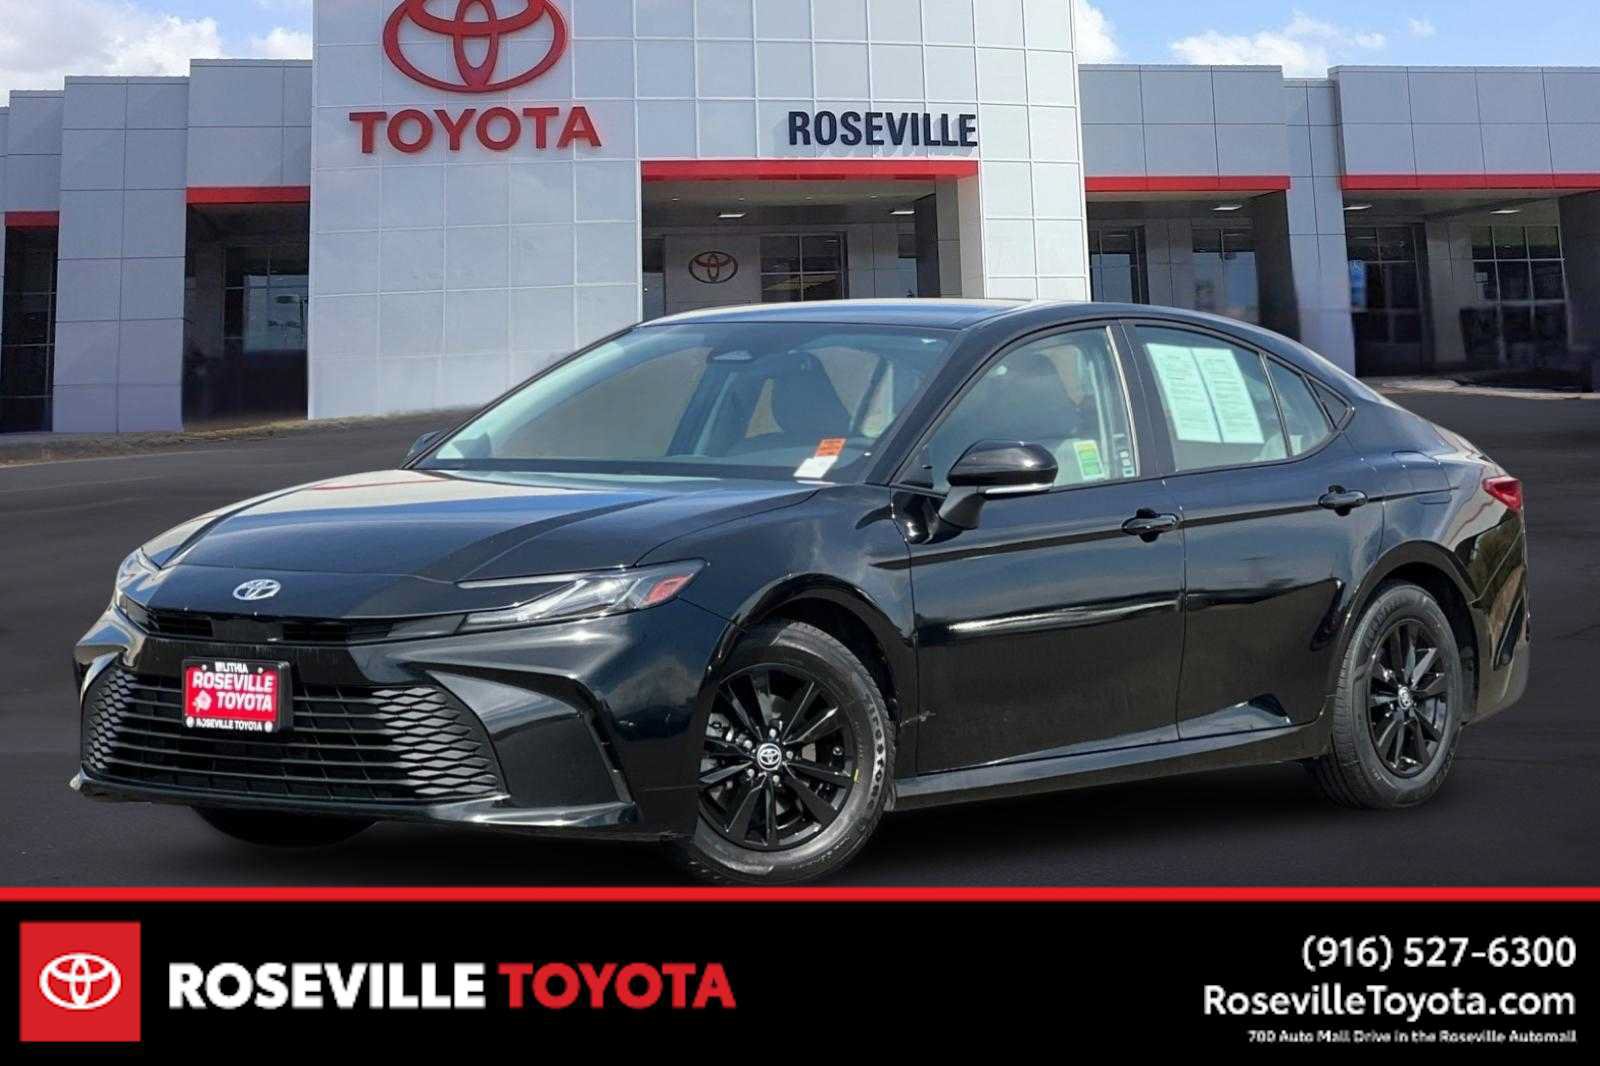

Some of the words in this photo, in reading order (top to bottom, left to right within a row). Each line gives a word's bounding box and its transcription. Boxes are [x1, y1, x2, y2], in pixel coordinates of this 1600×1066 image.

[349, 106, 602, 154] TOYOTA
[788, 110, 978, 147] ROSEVILLE
[192, 671, 274, 693] ROSEVILLE
[216, 691, 273, 712] TOYOTA
[196, 718, 234, 730] ROSEVILLE
[235, 720, 263, 732] TOYOTA
